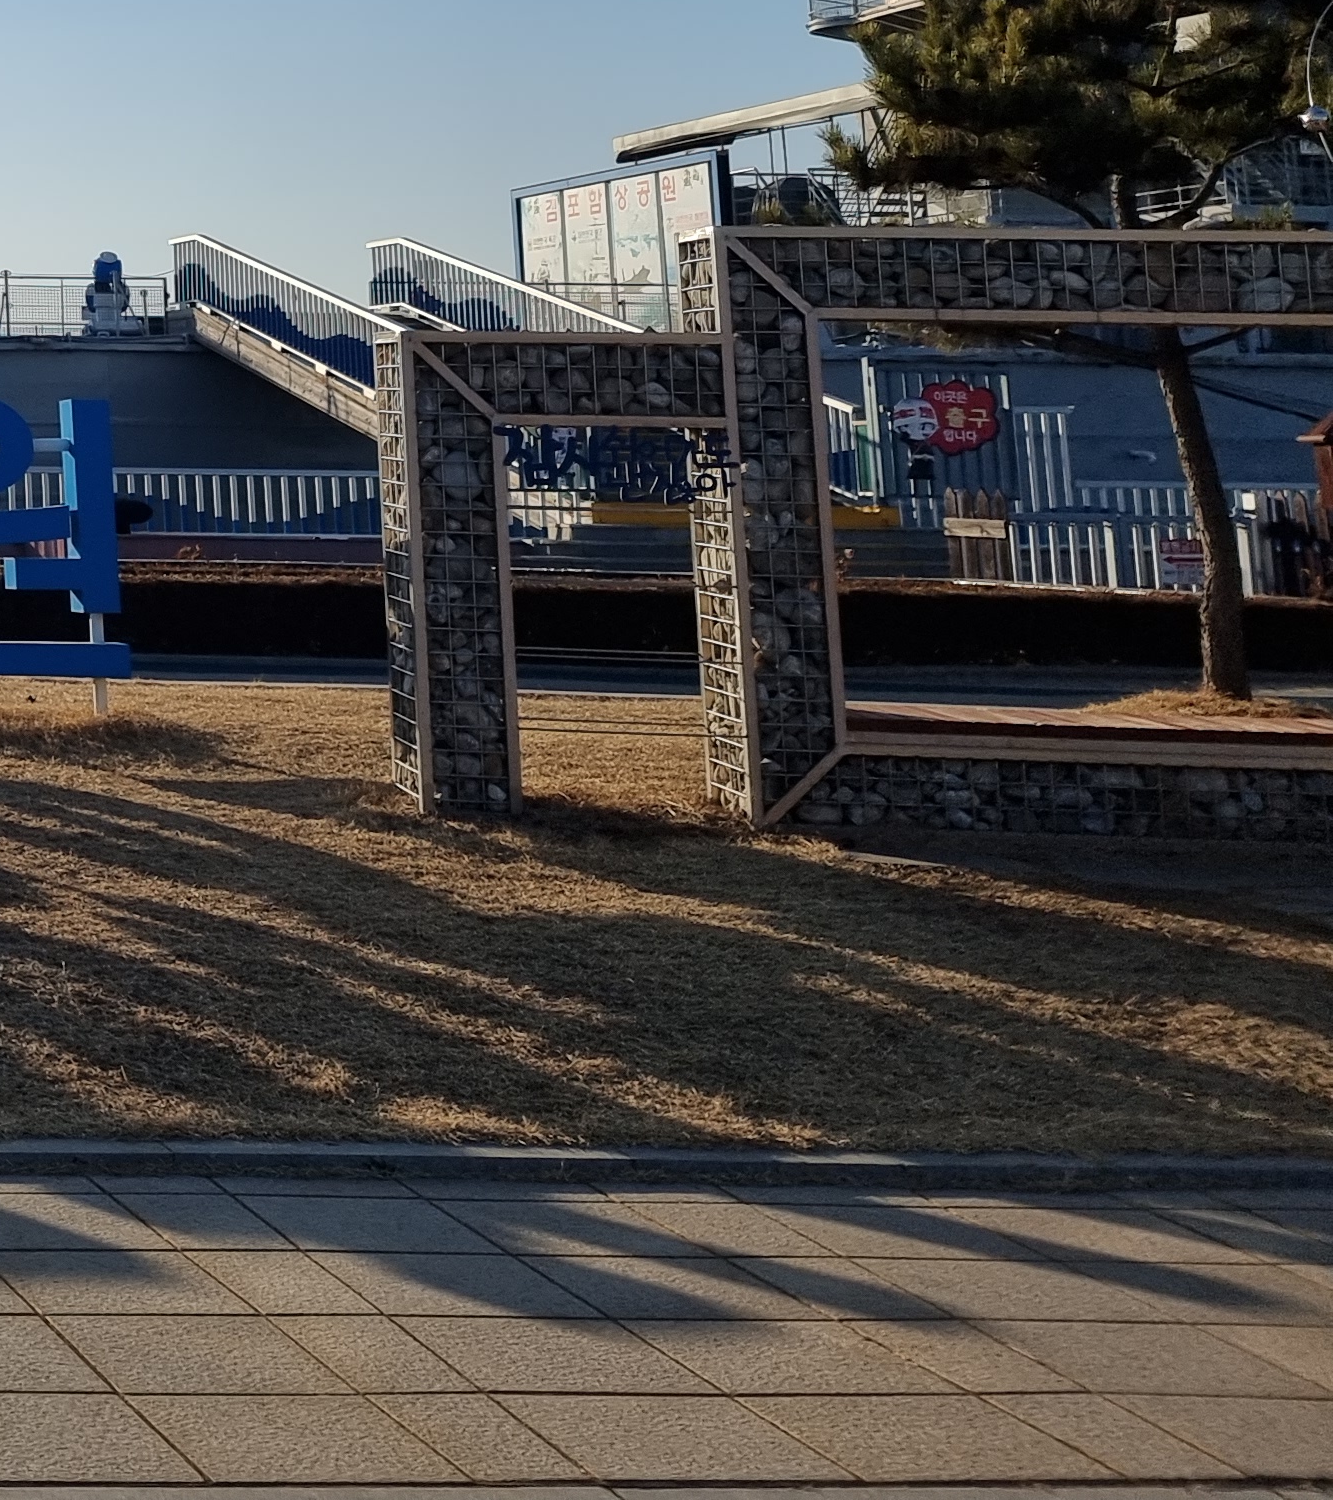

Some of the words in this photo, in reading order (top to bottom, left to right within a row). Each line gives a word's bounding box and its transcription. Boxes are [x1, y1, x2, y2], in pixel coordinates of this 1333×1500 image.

[545, 174, 677, 223] 김포함상공원
[934, 390, 967, 404] 이곳은
[944, 406, 990, 429] 출구
[943, 428, 977, 443] 입니다
